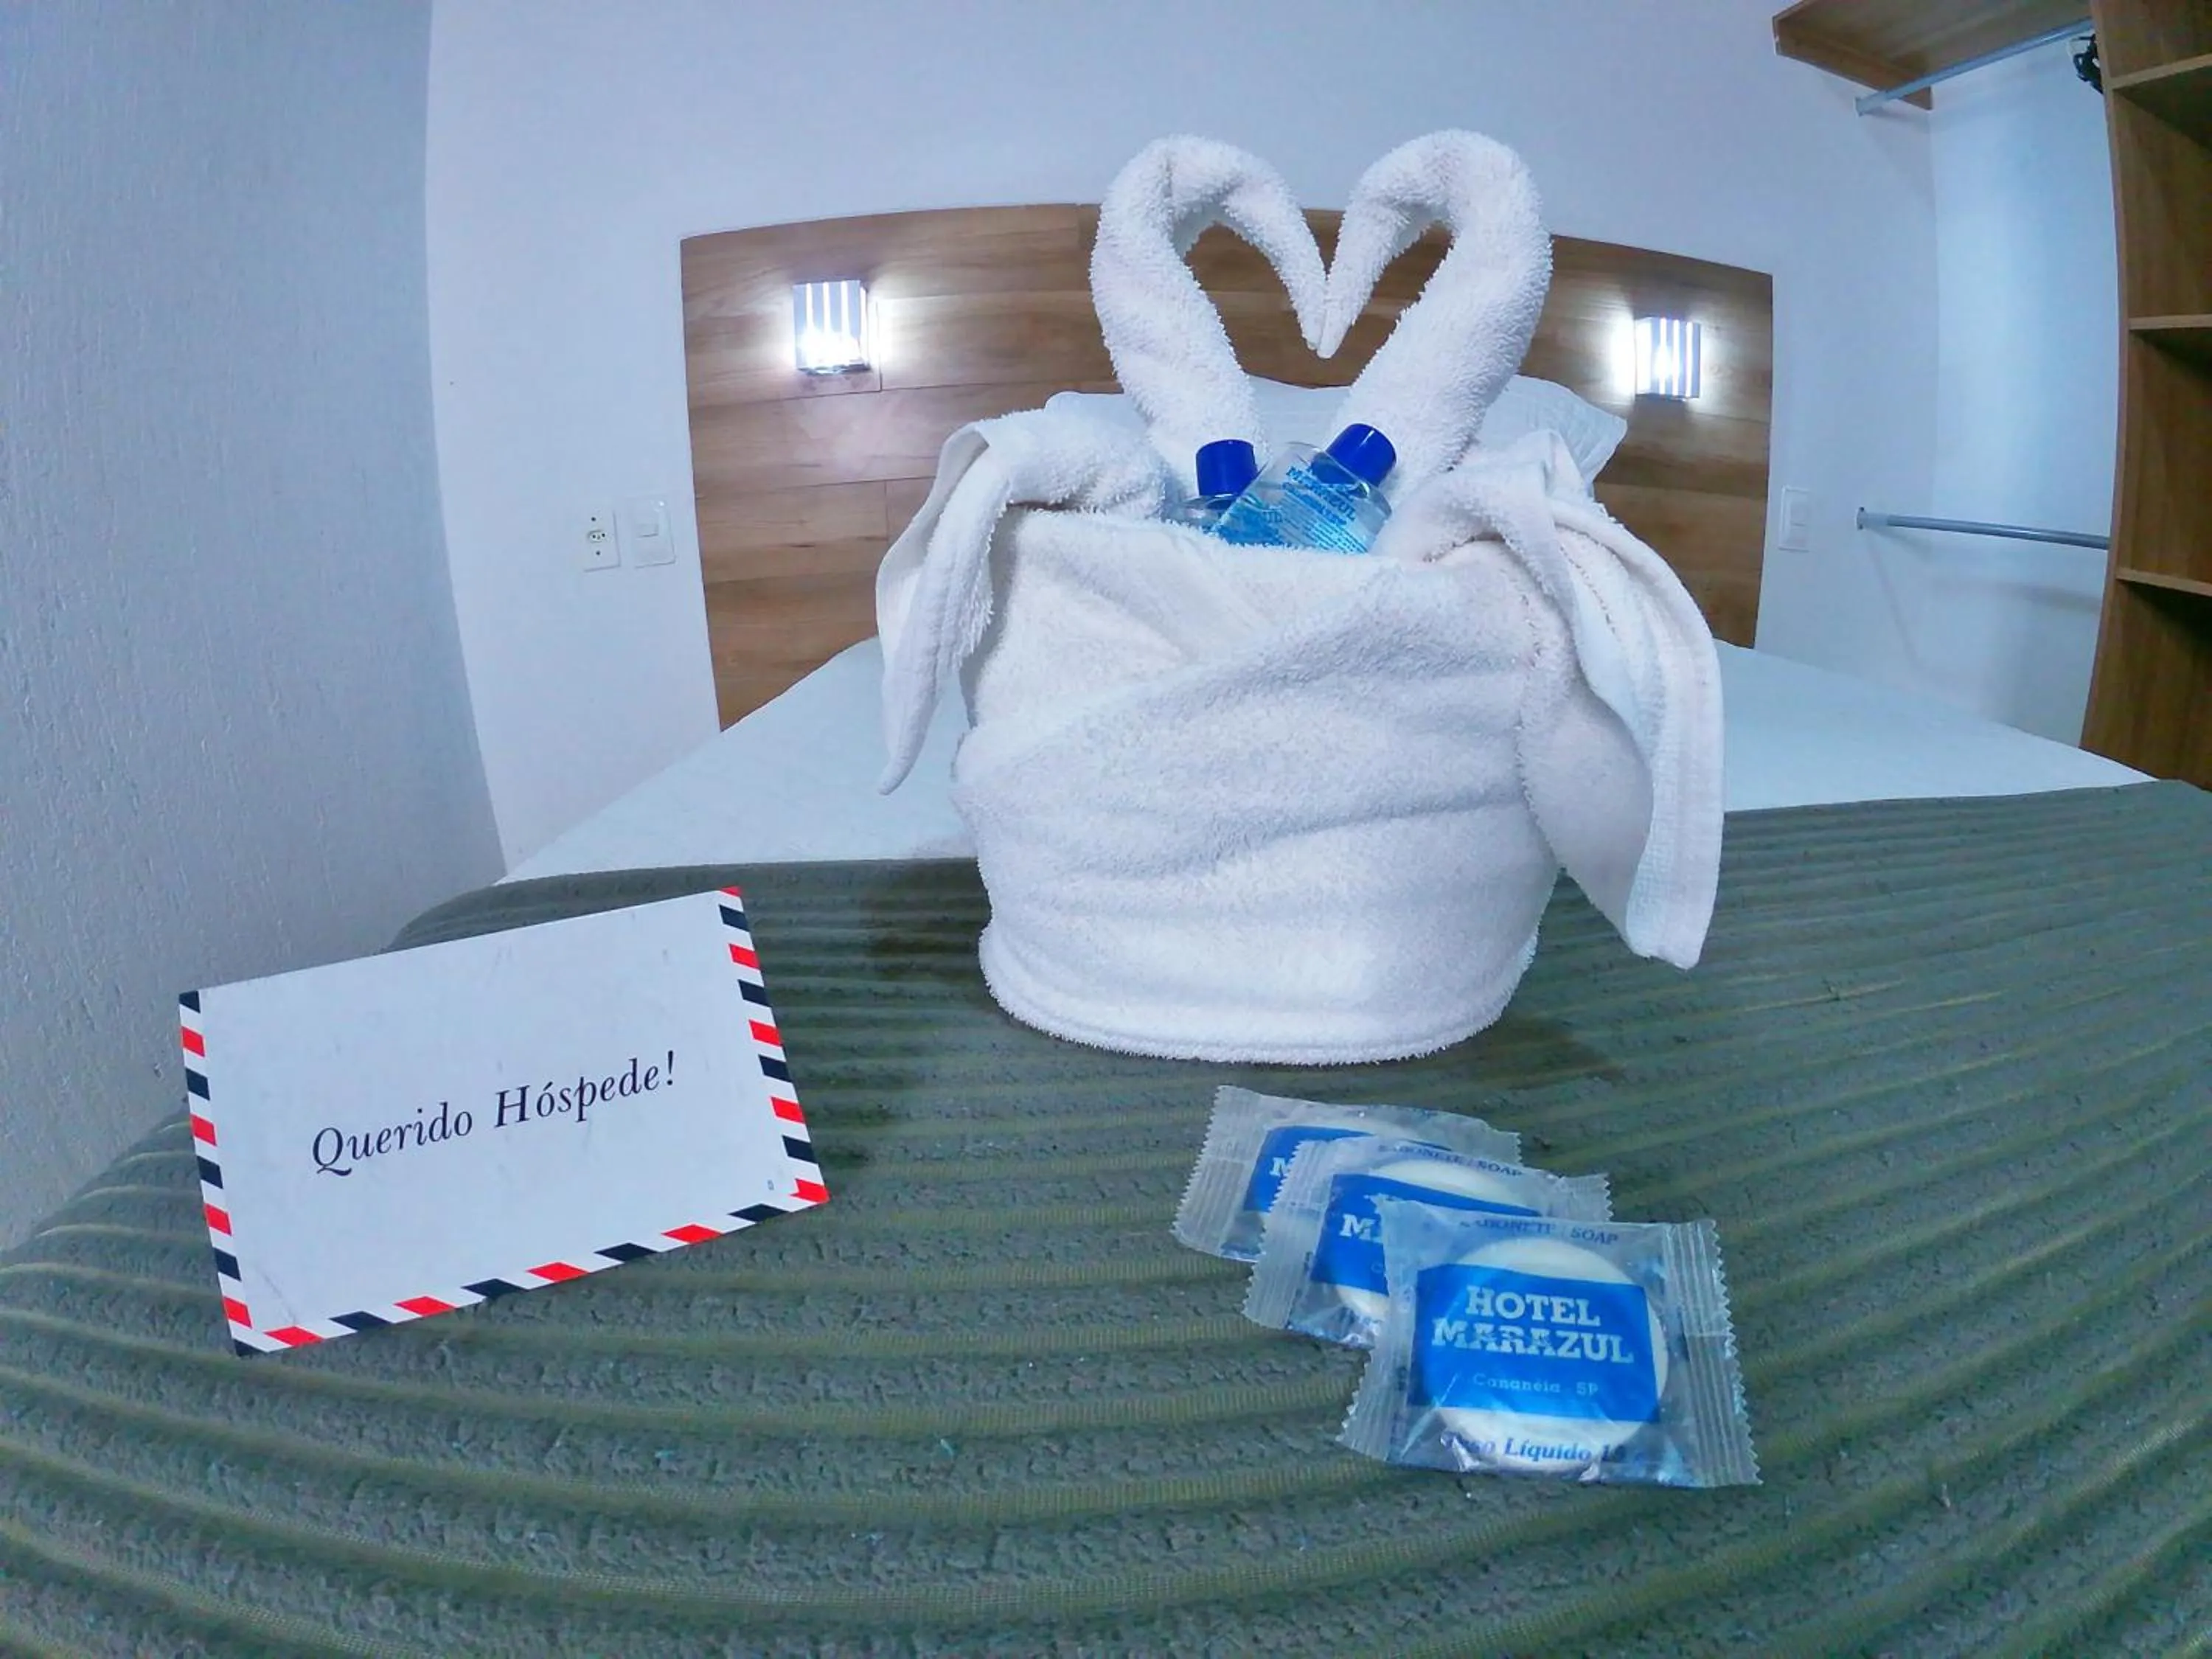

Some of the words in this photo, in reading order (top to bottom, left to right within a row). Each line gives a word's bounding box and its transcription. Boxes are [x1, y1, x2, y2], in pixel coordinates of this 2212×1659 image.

[312, 1102, 473, 1177] Querido
[493, 1050, 674, 1128] Hóspede!
[1570, 1226, 1619, 1246] SOAP
[1465, 1284, 1601, 1327] HOTEL
[1431, 1318, 1635, 1363] MARAZUL
[1576, 1381, 1599, 1397] SP
[1504, 1436, 1592, 1462] Líquido
